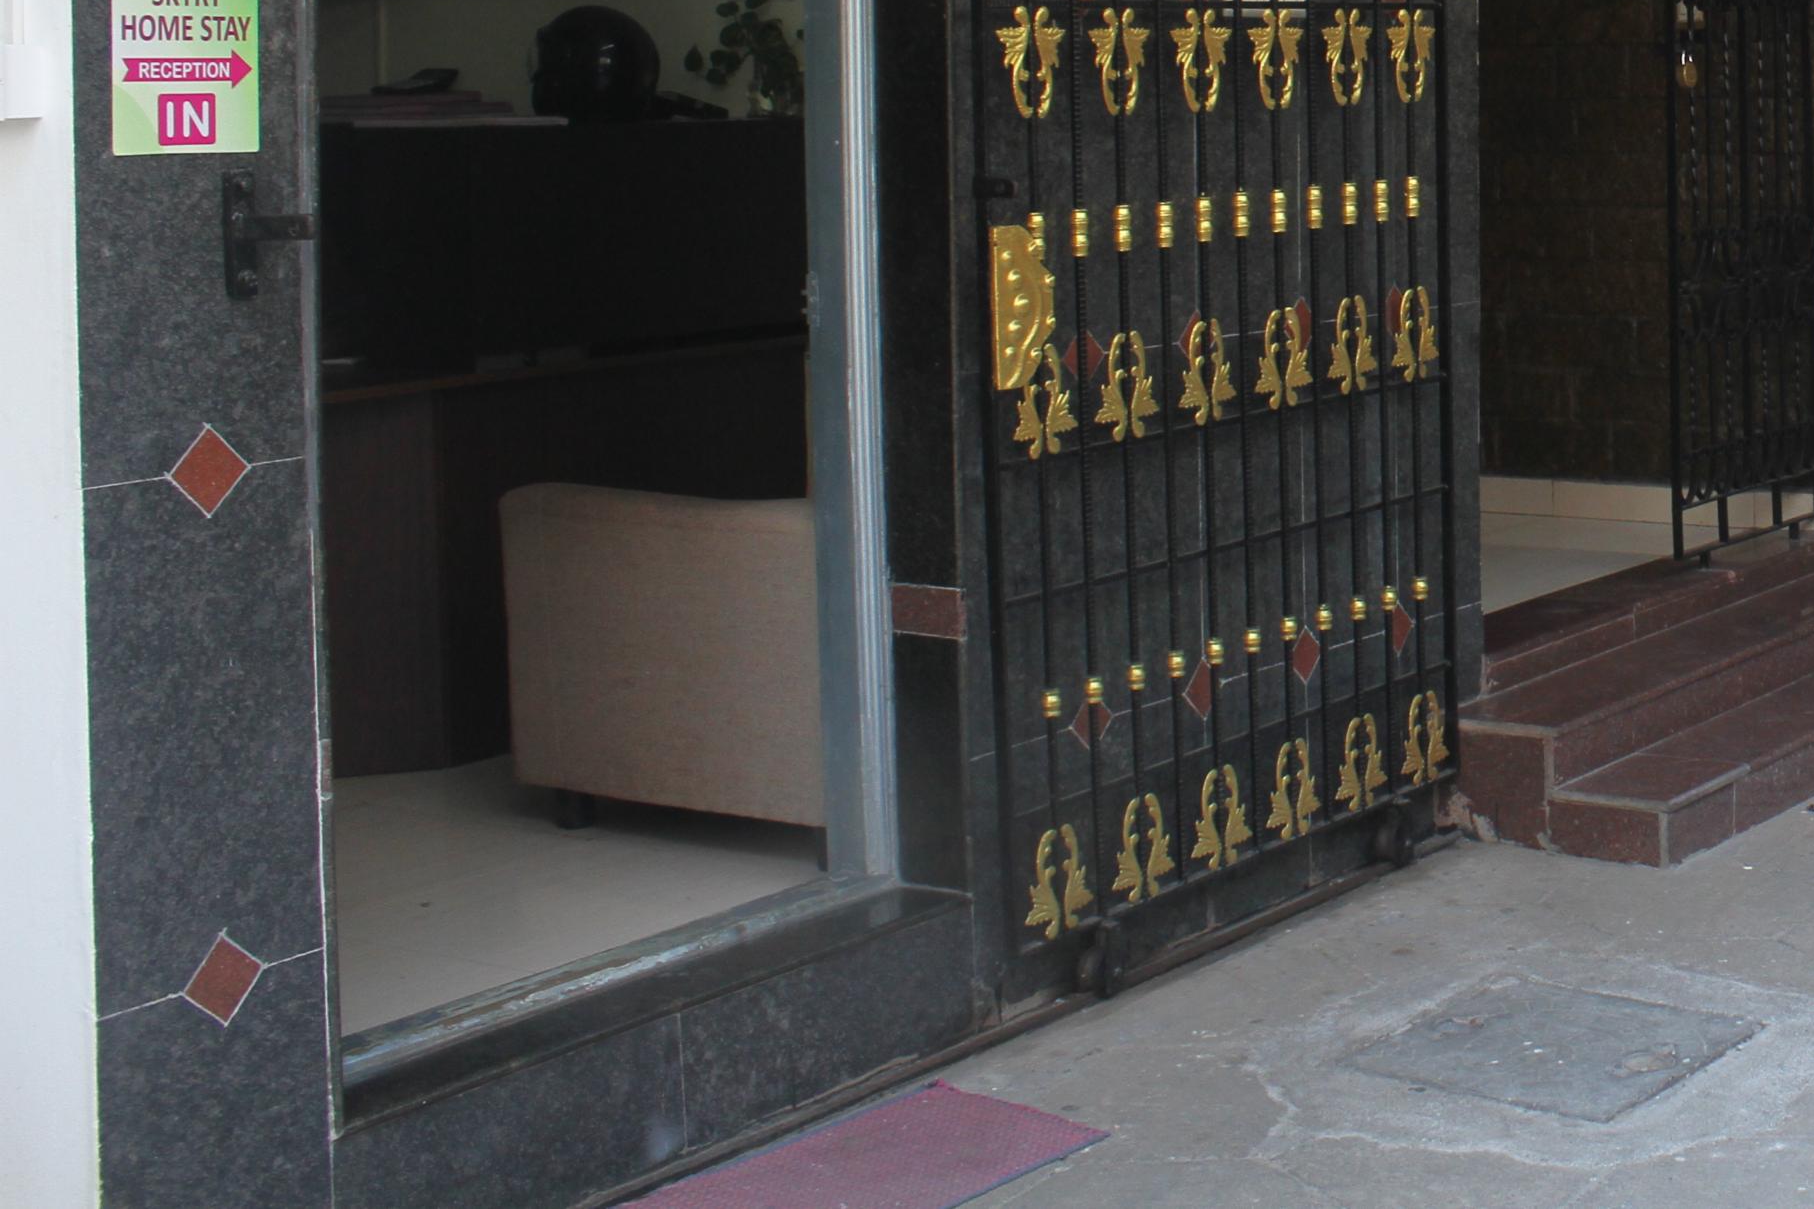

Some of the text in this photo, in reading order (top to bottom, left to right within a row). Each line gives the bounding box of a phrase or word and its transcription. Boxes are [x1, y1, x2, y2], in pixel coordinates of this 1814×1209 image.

[121, 14, 251, 42] HOME STAY
[138, 61, 231, 80] RECEPTION
[166, 100, 210, 138] IN
